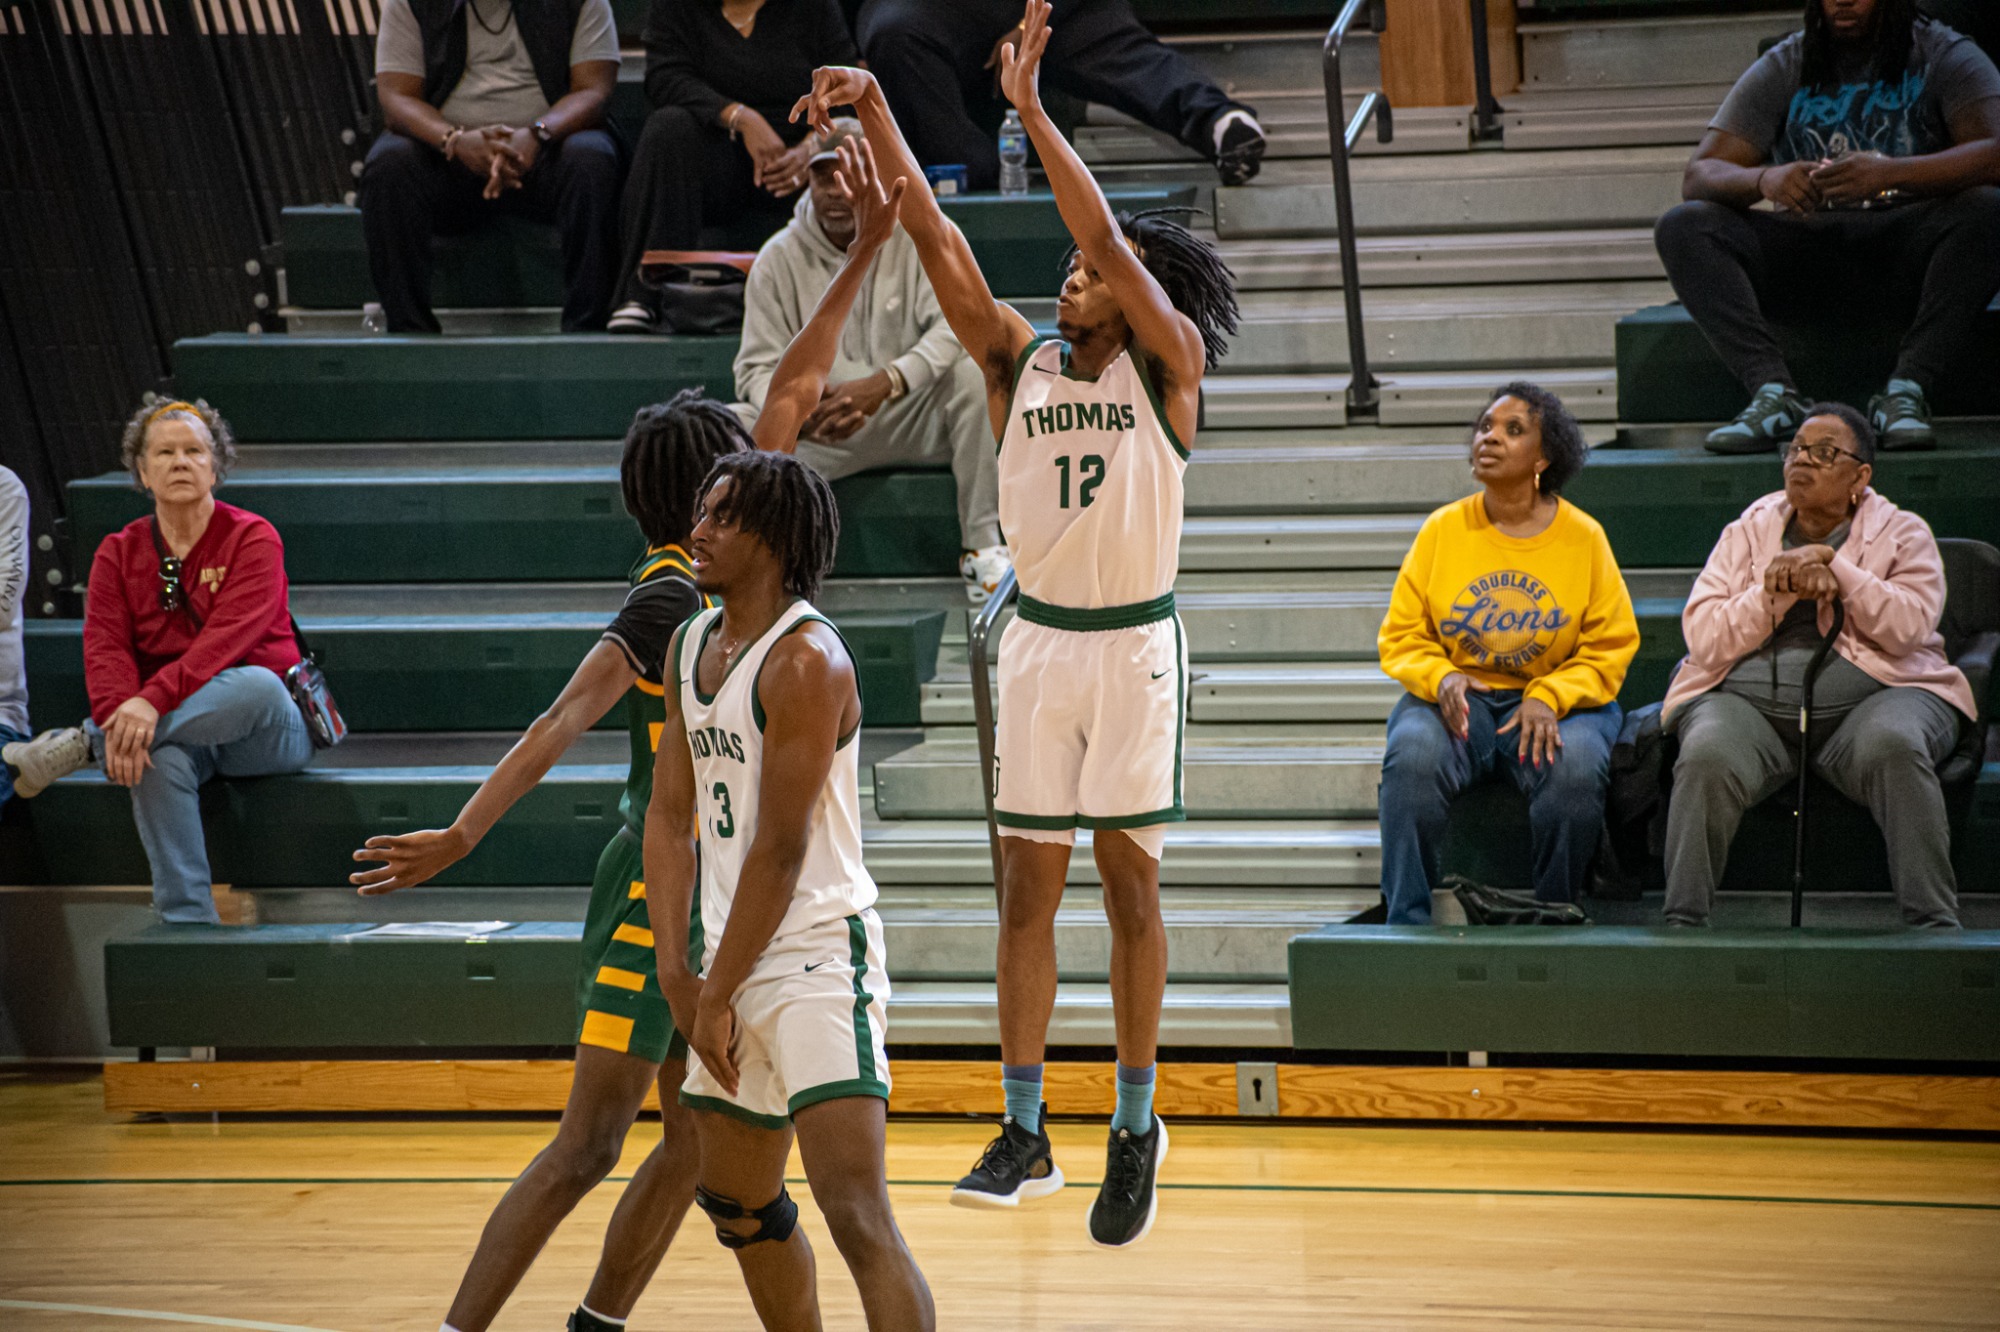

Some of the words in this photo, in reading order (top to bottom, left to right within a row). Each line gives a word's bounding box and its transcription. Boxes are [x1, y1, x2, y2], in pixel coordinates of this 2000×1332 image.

[1022, 402, 1136, 438] THOMAS
[1054, 454, 1106, 509] 12
[1468, 573, 1547, 601] DOUGLASS
[1440, 597, 1571, 637] Lions
[1494, 642, 1547, 668] SCHOOL
[688, 726, 745, 764] HOMAS
[705, 782, 735, 838] 3
